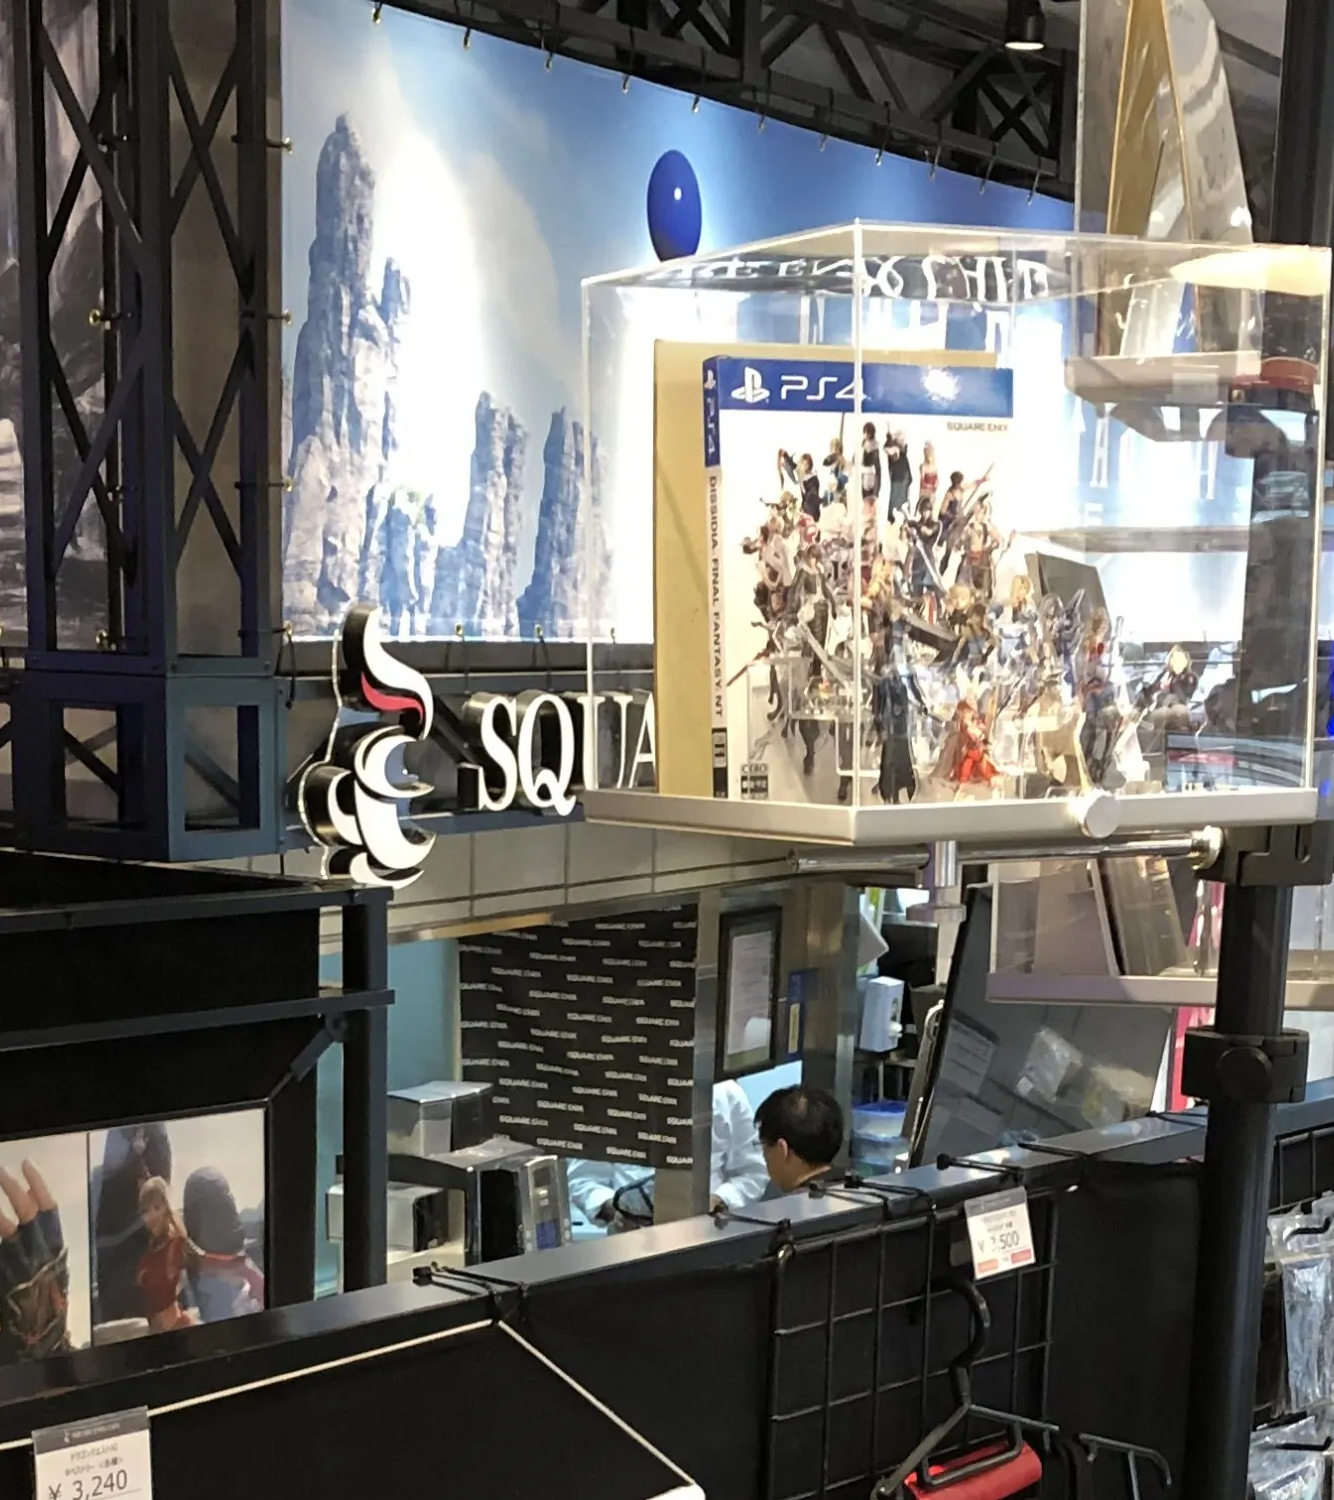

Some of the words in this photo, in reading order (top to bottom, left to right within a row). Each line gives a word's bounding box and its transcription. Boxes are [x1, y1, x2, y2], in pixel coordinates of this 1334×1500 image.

[780, 376, 868, 402] PS4
[708, 476, 719, 550] DISSIDIA
[712, 558, 720, 607] FINAL
[712, 611, 722, 688] FANTASY
